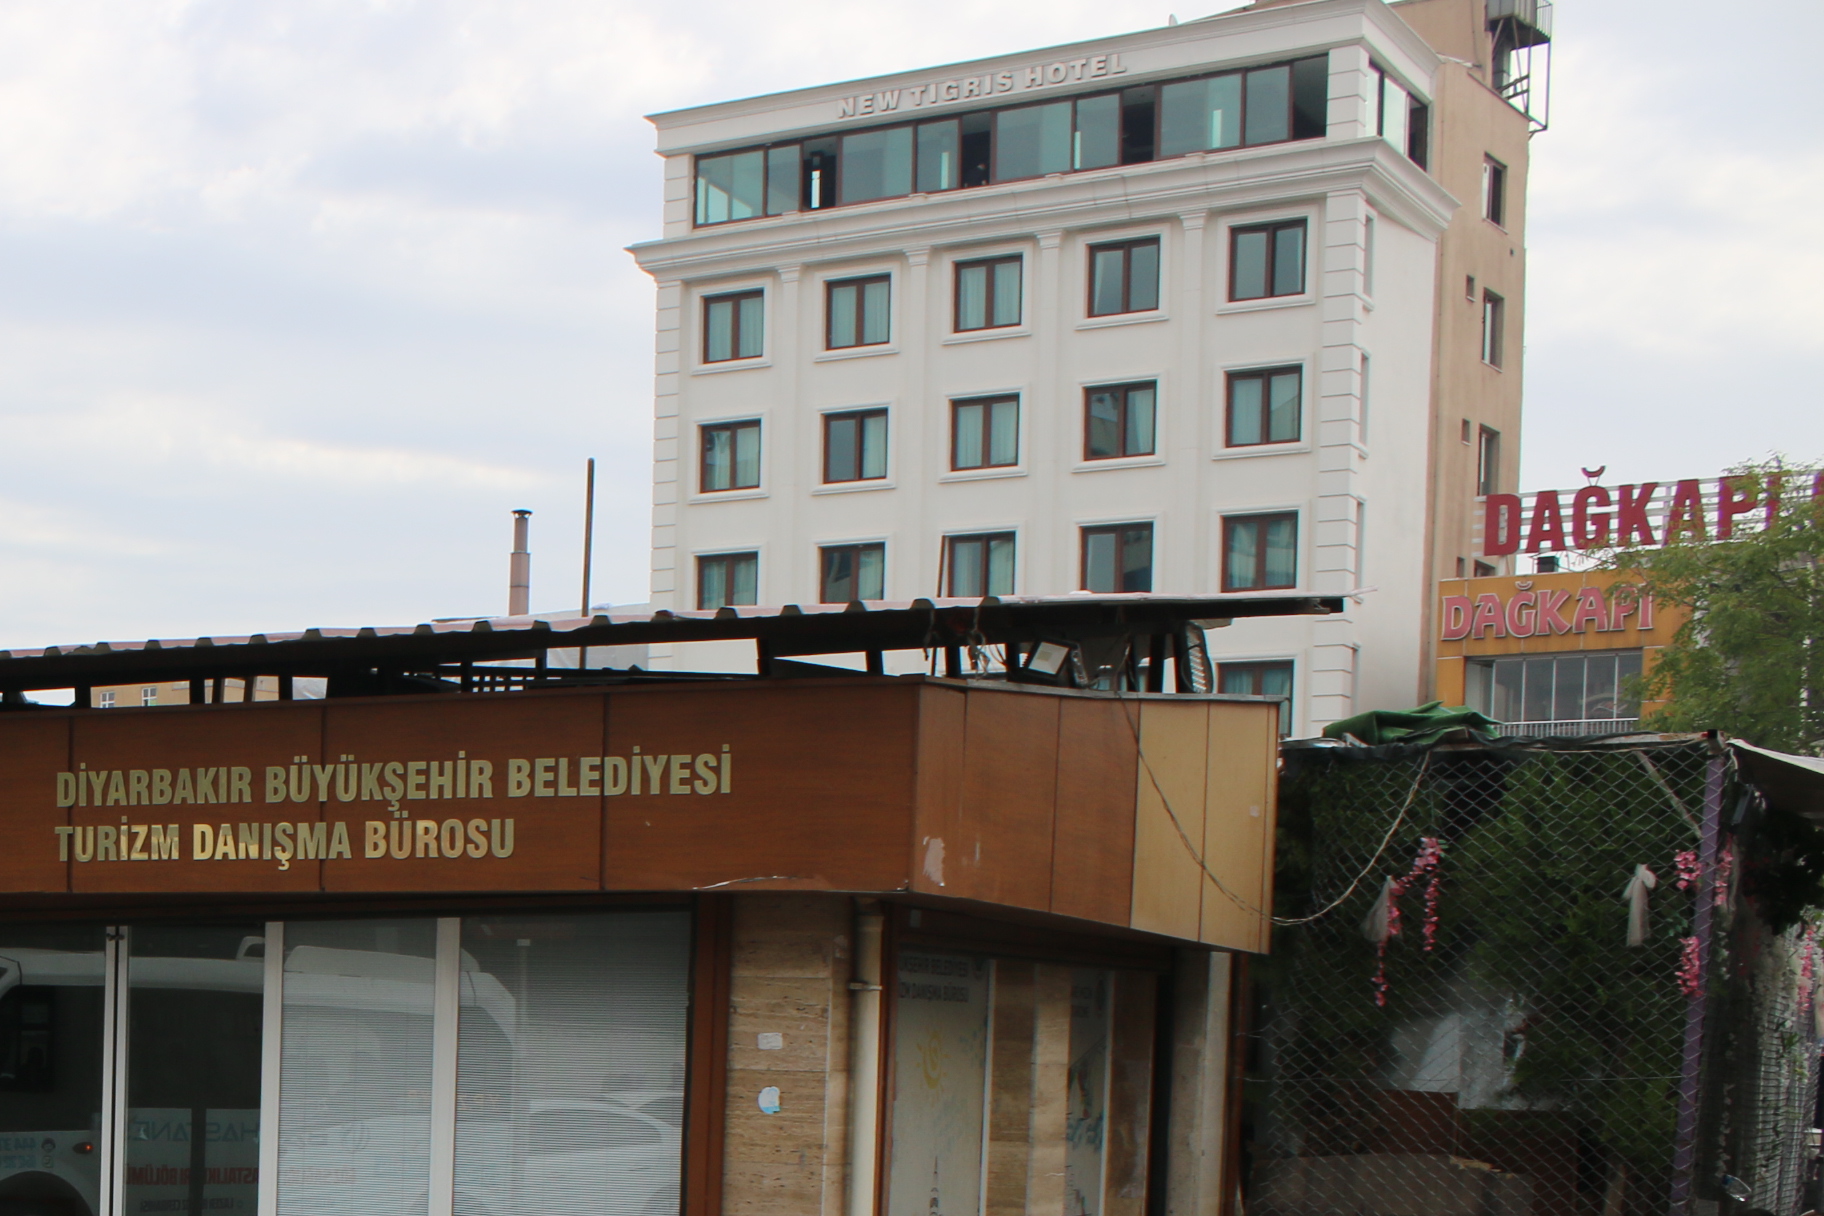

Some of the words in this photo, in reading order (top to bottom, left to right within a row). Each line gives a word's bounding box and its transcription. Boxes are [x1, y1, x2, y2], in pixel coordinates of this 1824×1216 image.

[837, 90, 901, 119] NEW
[910, 71, 1014, 106] TIGRIS
[1024, 53, 1126, 88] HOTEL
[1441, 581, 1655, 641] DAĞKAPI
[55, 763, 252, 807] DİYARBAKIR
[265, 751, 493, 811] BÜYÜKŞEHİR
[507, 744, 731, 797] BELEDİYESİ
[55, 815, 179, 862] TURİZM
[192, 821, 352, 870] DANIŞMA
[364, 811, 515, 860] BÜROSU
